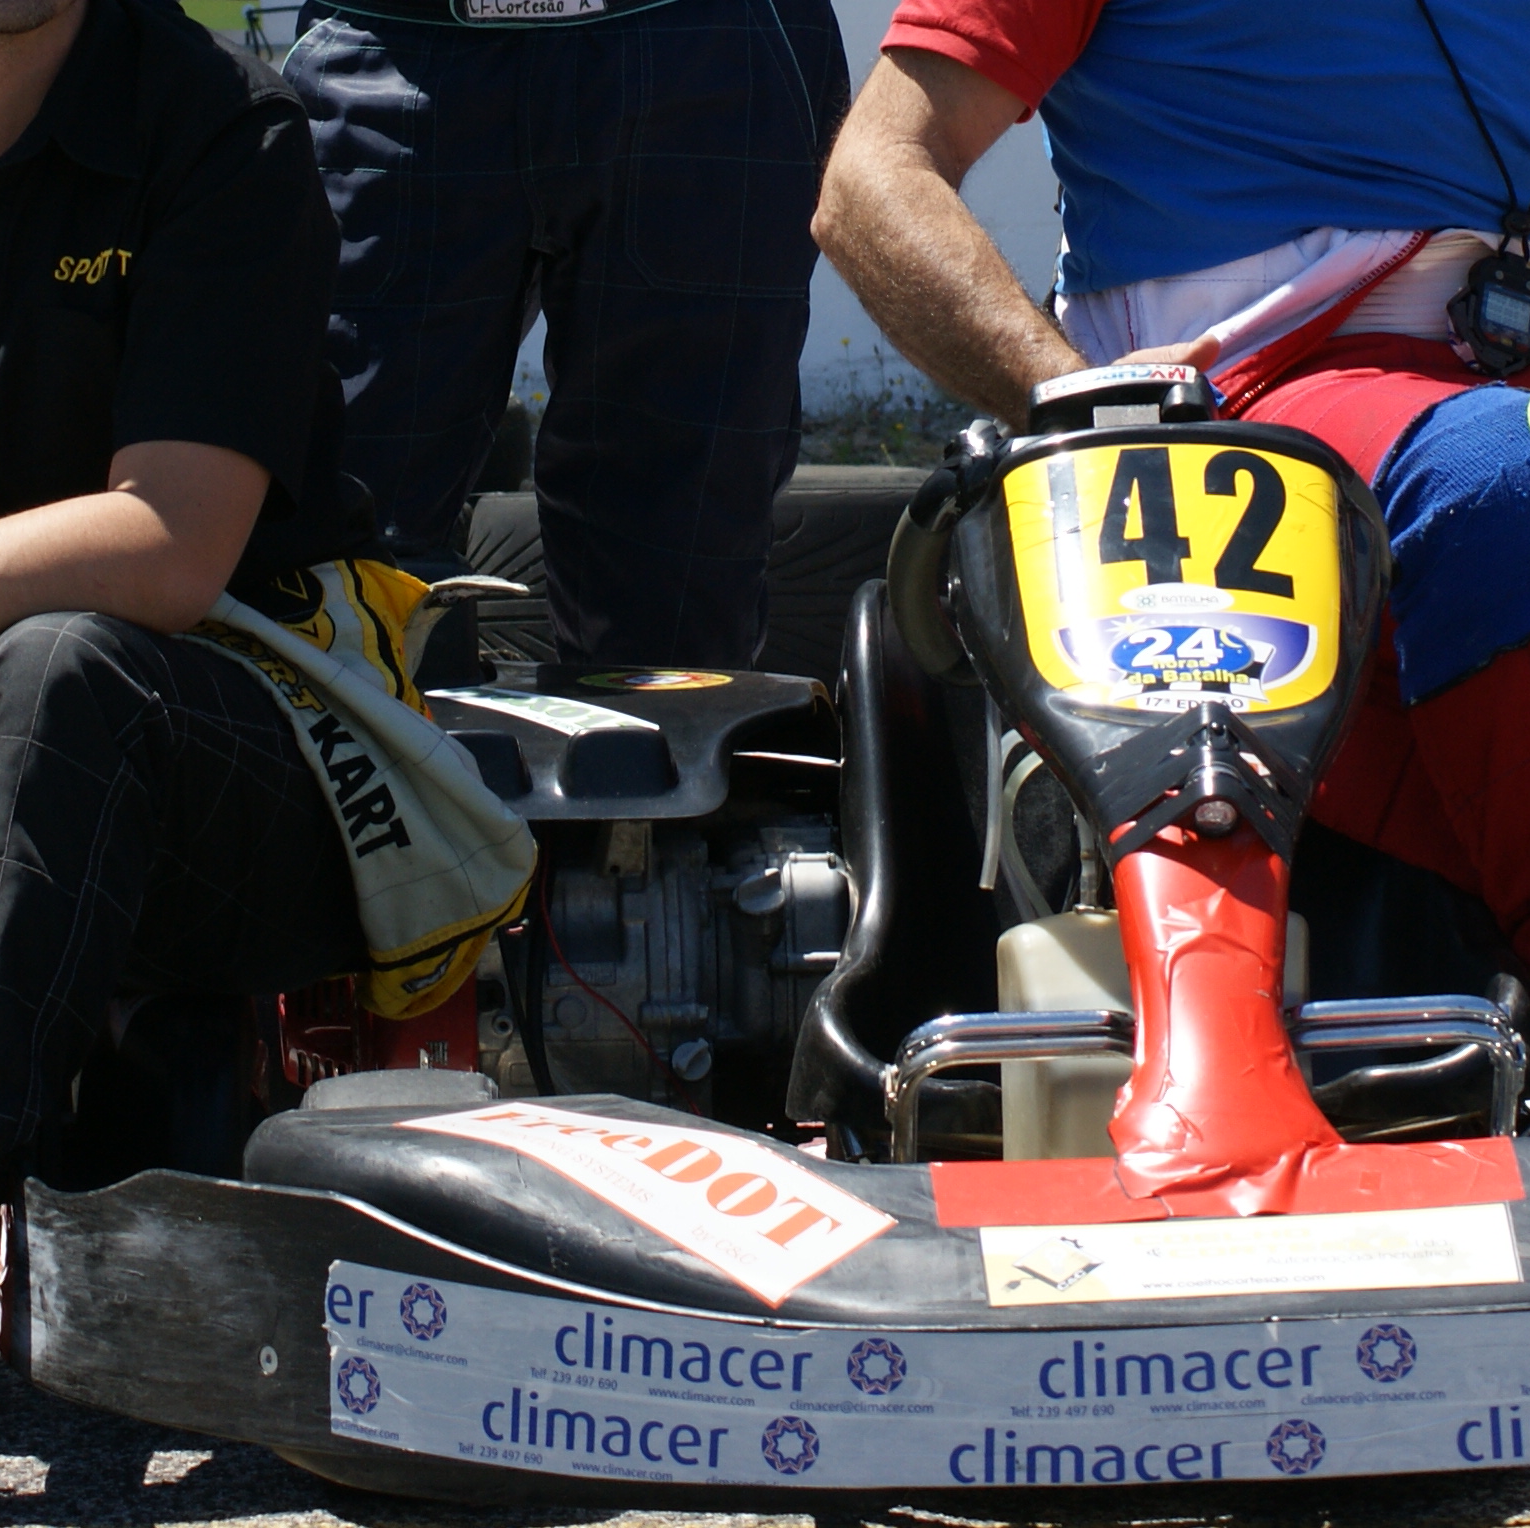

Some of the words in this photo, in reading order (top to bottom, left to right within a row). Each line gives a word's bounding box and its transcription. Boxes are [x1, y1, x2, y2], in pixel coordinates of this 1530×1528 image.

[1098, 446, 1296, 601] 42
[1160, 594, 1220, 604] BATALHA
[1128, 628, 1224, 668] 24
[1152, 658, 1210, 669] horas
[1127, 671, 1156, 686] da
[1162, 668, 1251, 686] Batalha
[309, 713, 411, 859] KART
[469, 1110, 842, 1251] FreeDOT
[569, 1151, 655, 1204] SYSTEMS
[691, 1224, 713, 1245] by
[356, 1336, 468, 1368] climacer@climacer.com
[555, 1311, 813, 1392] climacer
[1038, 1340, 1321, 1399] climacer
[553, 1370, 571, 1384] 239
[575, 1374, 595, 1388] 497
[598, 1377, 618, 1391] 690
[648, 1385, 755, 1408] www.climacer.com
[789, 1399, 936, 1415] climacer@climacer.com
[1037, 1405, 1060, 1417] 239
[1065, 1404, 1087, 1417] 497
[1092, 1403, 1115, 1416] 690
[1150, 1397, 1266, 1414] www.climacer.com
[1300, 1389, 1447, 1407] climacer@climacer.com
[482, 1386, 729, 1469] climacer
[479, 1445, 498, 1459] 239
[502, 1448, 520, 1462] 497
[524, 1451, 543, 1465] 690
[571, 1459, 674, 1483] www.climacer.com
[948, 1427, 1232, 1484] climacer
